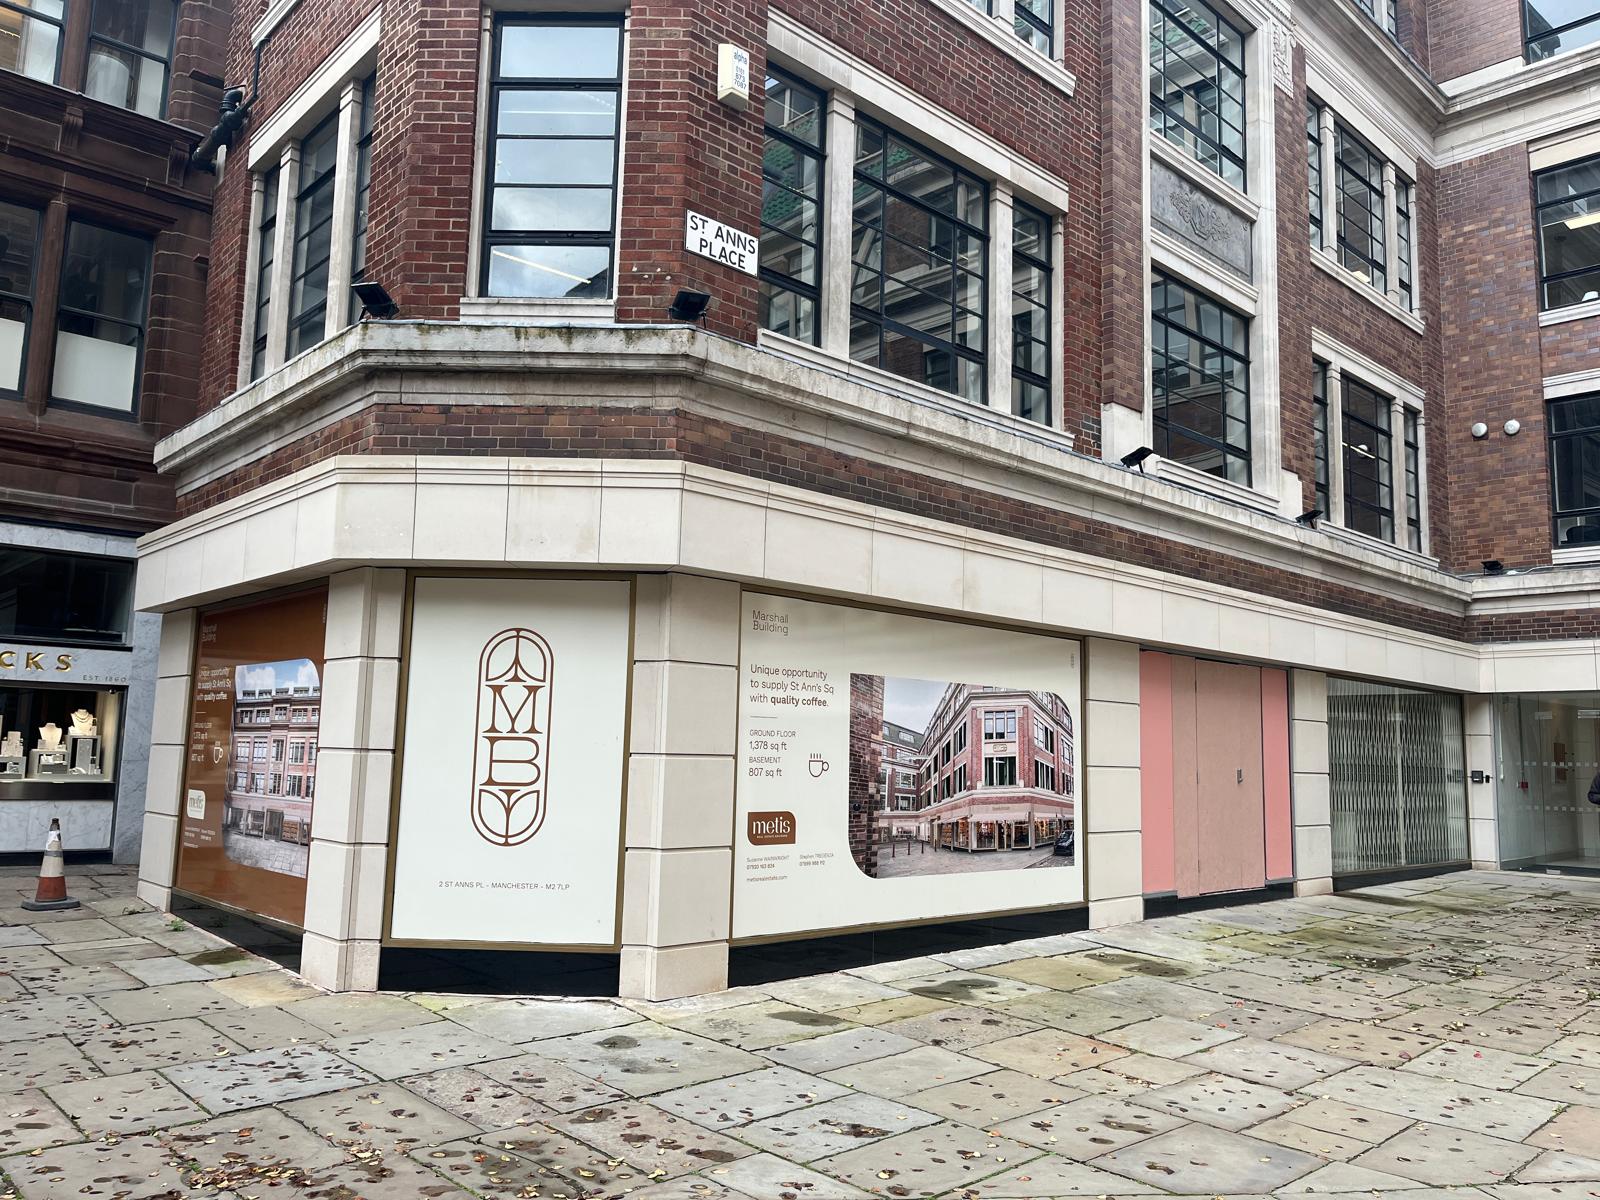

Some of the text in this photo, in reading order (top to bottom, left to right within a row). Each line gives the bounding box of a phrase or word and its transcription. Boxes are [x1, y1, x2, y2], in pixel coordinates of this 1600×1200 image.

[714, 225, 756, 255] ANNS
[699, 237, 746, 270] PLACE
[752, 609, 789, 623] Marshall
[752, 620, 789, 636] Building
[750, 663, 828, 681] Unique opportunity
[750, 679, 834, 695] to supply St Ann's Sq
[749, 693, 829, 707] with quality coffee.
[749, 729, 796, 738] GROUND FLOOR
[749, 740, 787, 752] 1,378 sq ft
[748, 756, 781, 764] BASEMENT
[748, 767, 782, 779] 807 sq ft
[752, 816, 791, 834] metis
[491, 882, 539, 890] MANCHESTER
